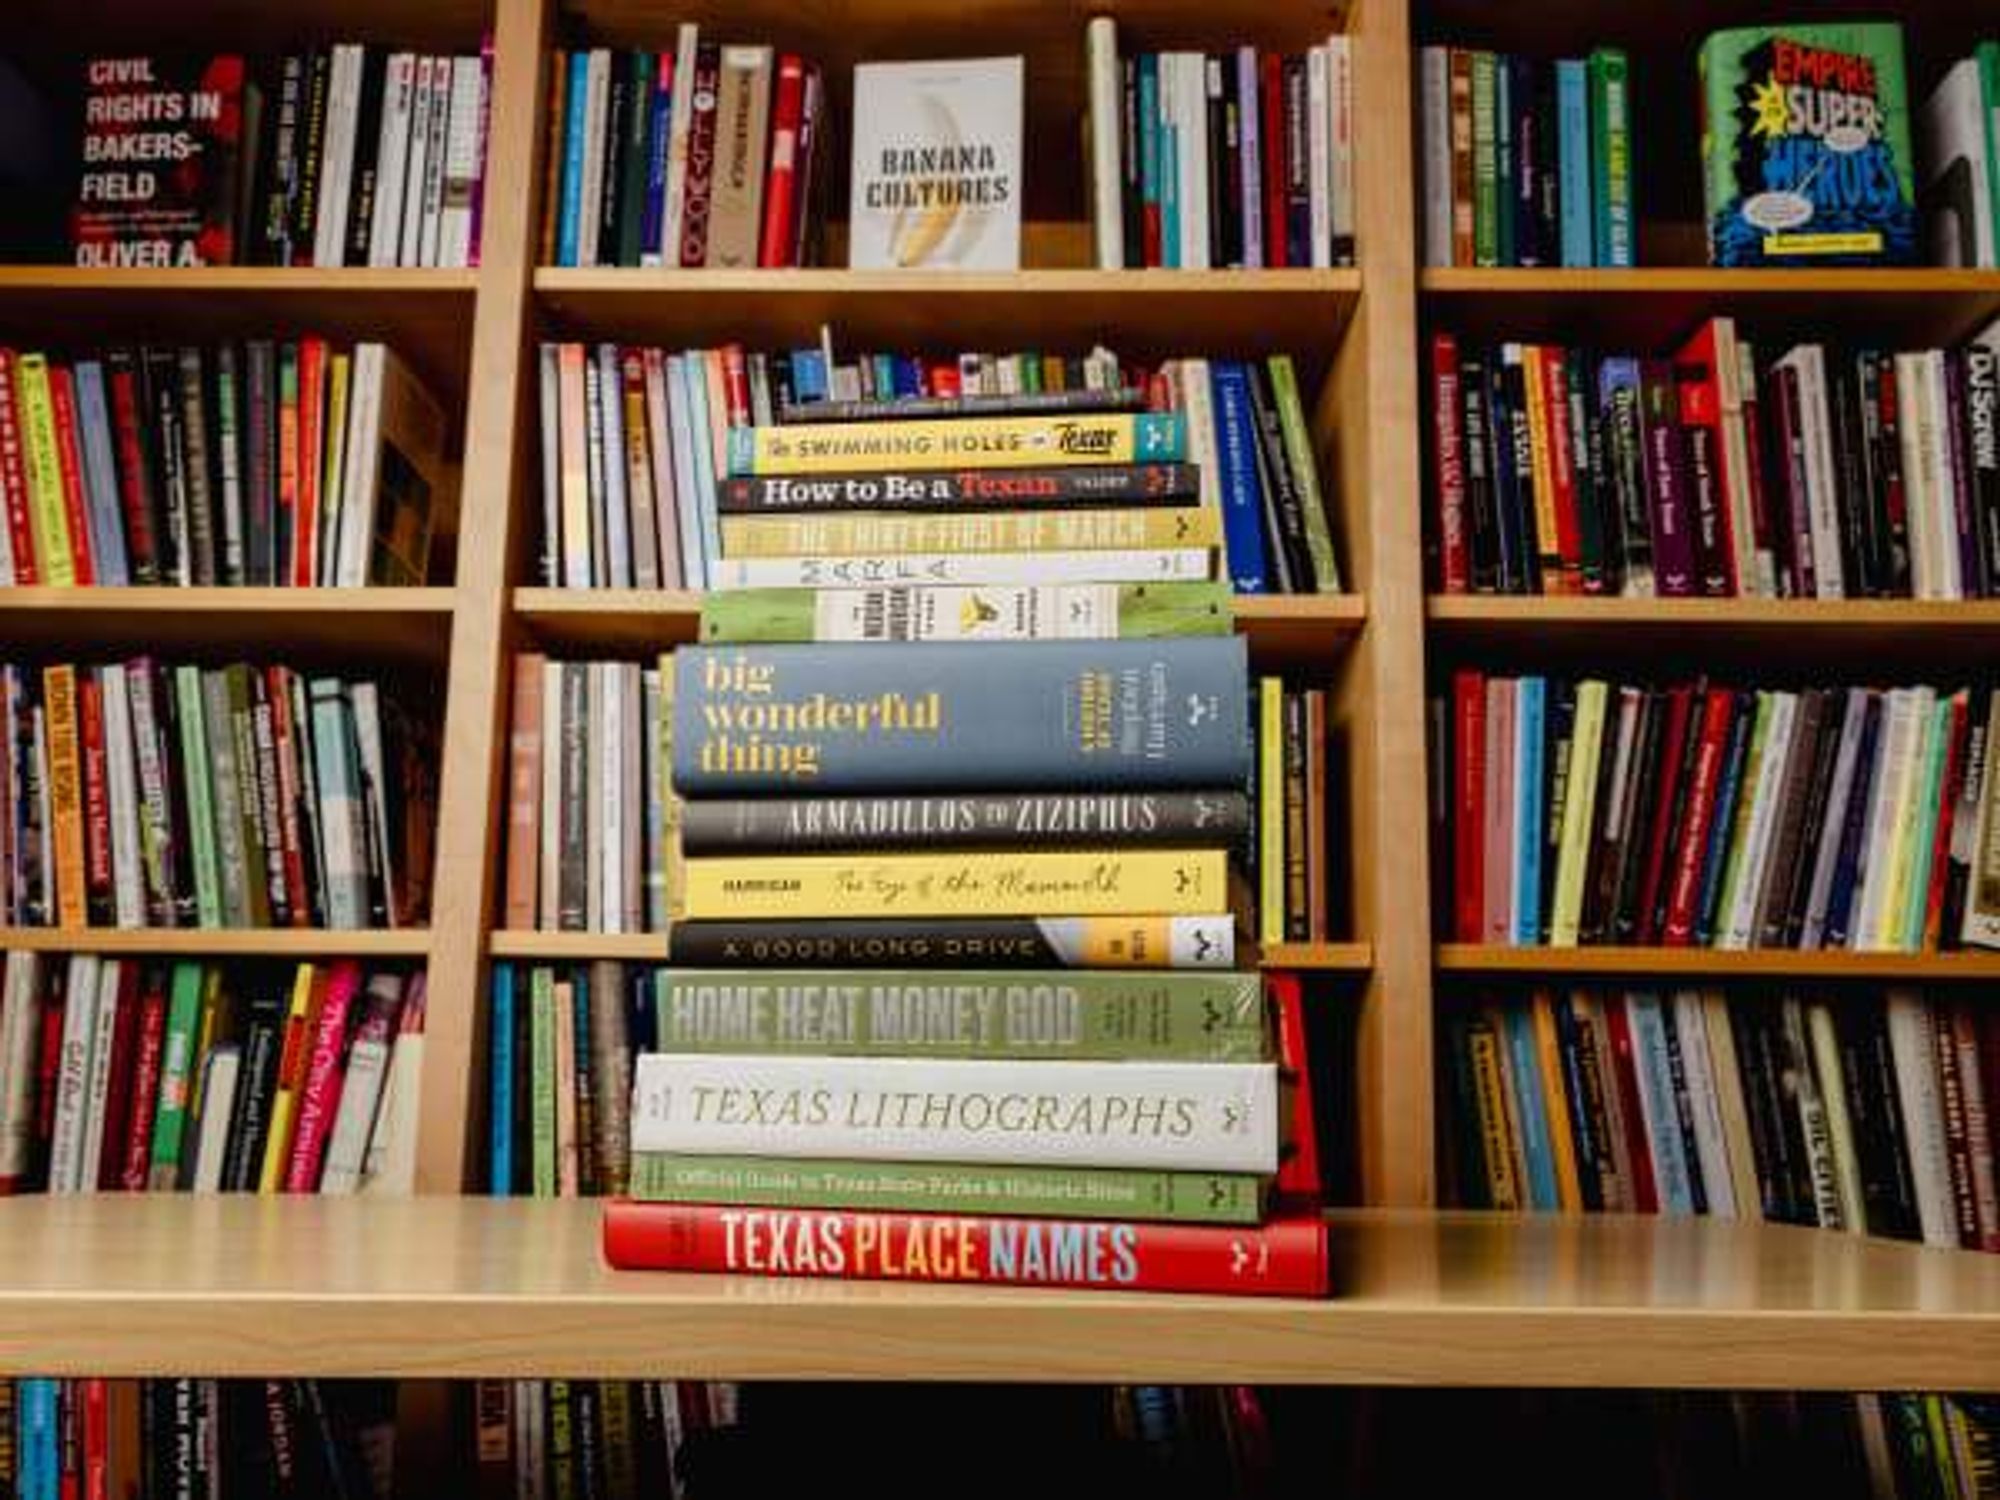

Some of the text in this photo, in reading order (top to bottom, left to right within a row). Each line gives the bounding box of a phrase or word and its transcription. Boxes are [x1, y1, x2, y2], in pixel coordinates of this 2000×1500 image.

[89, 58, 155, 85] CIVIL
[1773, 40, 1876, 94] EMPIRE
[86, 92, 221, 123] RIGHTS IN
[84, 132, 203, 161] BAKERS-
[881, 144, 996, 175] BANANA
[80, 172, 155, 202] FIELD
[866, 176, 1010, 208] CULTURES
[76, 241, 171, 267] OLIVER
[1970, 351, 1998, 470] DJ Screw
[799, 436, 931, 457] SWIMMING
[943, 434, 1021, 453] HOLES
[1054, 423, 1118, 452] Texas
[764, 480, 841, 504] How
[844, 481, 877, 502] to
[885, 477, 926, 500] Be
[930, 482, 951, 499] a
[958, 472, 1058, 498] Texan
[706, 657, 774, 695] big
[703, 692, 940, 733] wonderful
[701, 734, 819, 775] thing
[791, 800, 976, 835] ARMADILLOS
[1016, 798, 1157, 832] ZIZIPHUS
[942, 869, 985, 891] the
[996, 862, 1122, 896] Mammoth
[753, 940, 836, 959] GOOD
[849, 940, 931, 958] LONG
[945, 938, 1037, 956] DRIVE
[674, 985, 772, 1045] HOME
[777, 985, 858, 1045] HEAT
[871, 986, 993, 1045] MONEY
[1006, 986, 1081, 1045] GOD
[689, 1086, 830, 1125] TEXAS
[846, 1090, 1196, 1138] LITHOGRAPHS
[677, 1170, 741, 1189] Official
[824, 1174, 875, 1191] Texas
[930, 1177, 980, 1195] Parks
[719, 1214, 845, 1272] TEXAS
[853, 1216, 978, 1278] PLACE
[988, 1221, 1140, 1283] NAMES
